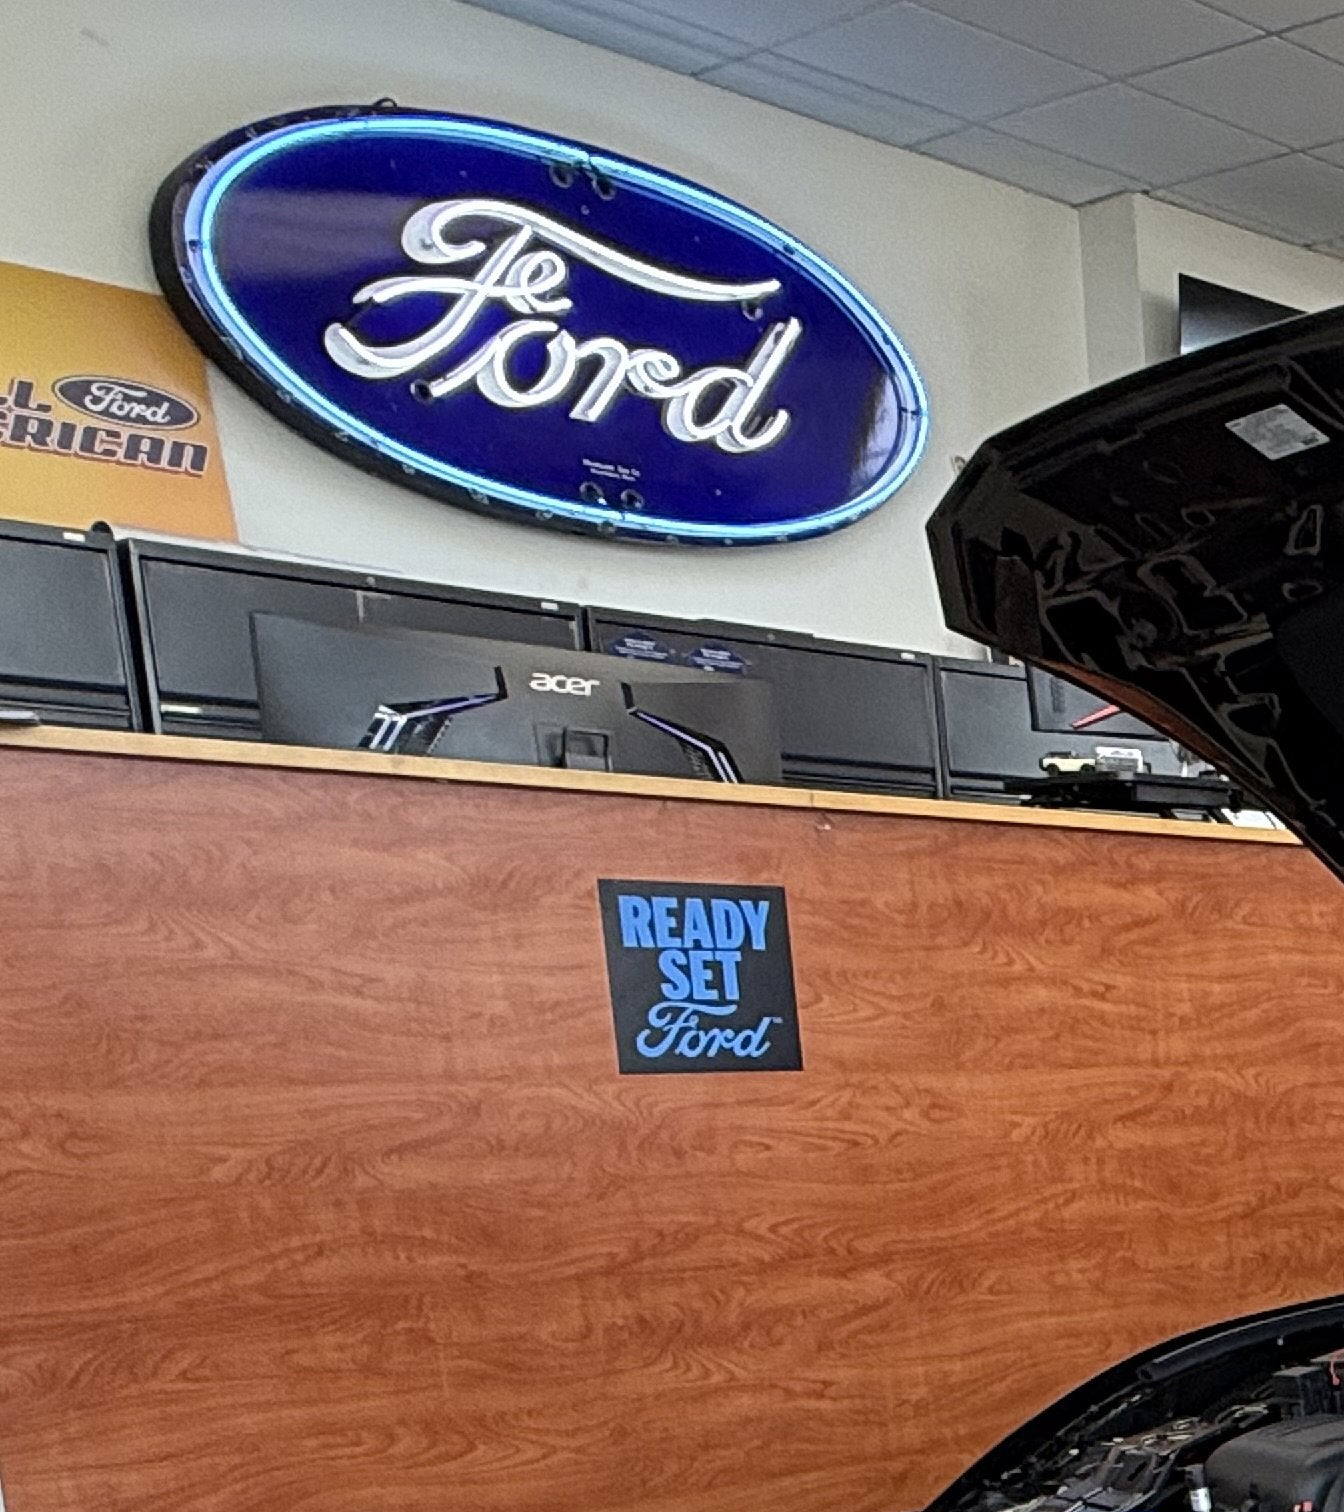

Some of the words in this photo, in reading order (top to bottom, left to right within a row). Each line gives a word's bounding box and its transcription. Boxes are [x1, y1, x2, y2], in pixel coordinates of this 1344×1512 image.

[324, 198, 802, 454] Ford
[83, 381, 173, 424] Ford
[528, 671, 601, 698] acer
[616, 894, 770, 951] READY
[657, 948, 742, 1001] SET
[635, 1000, 772, 1058] Ford
